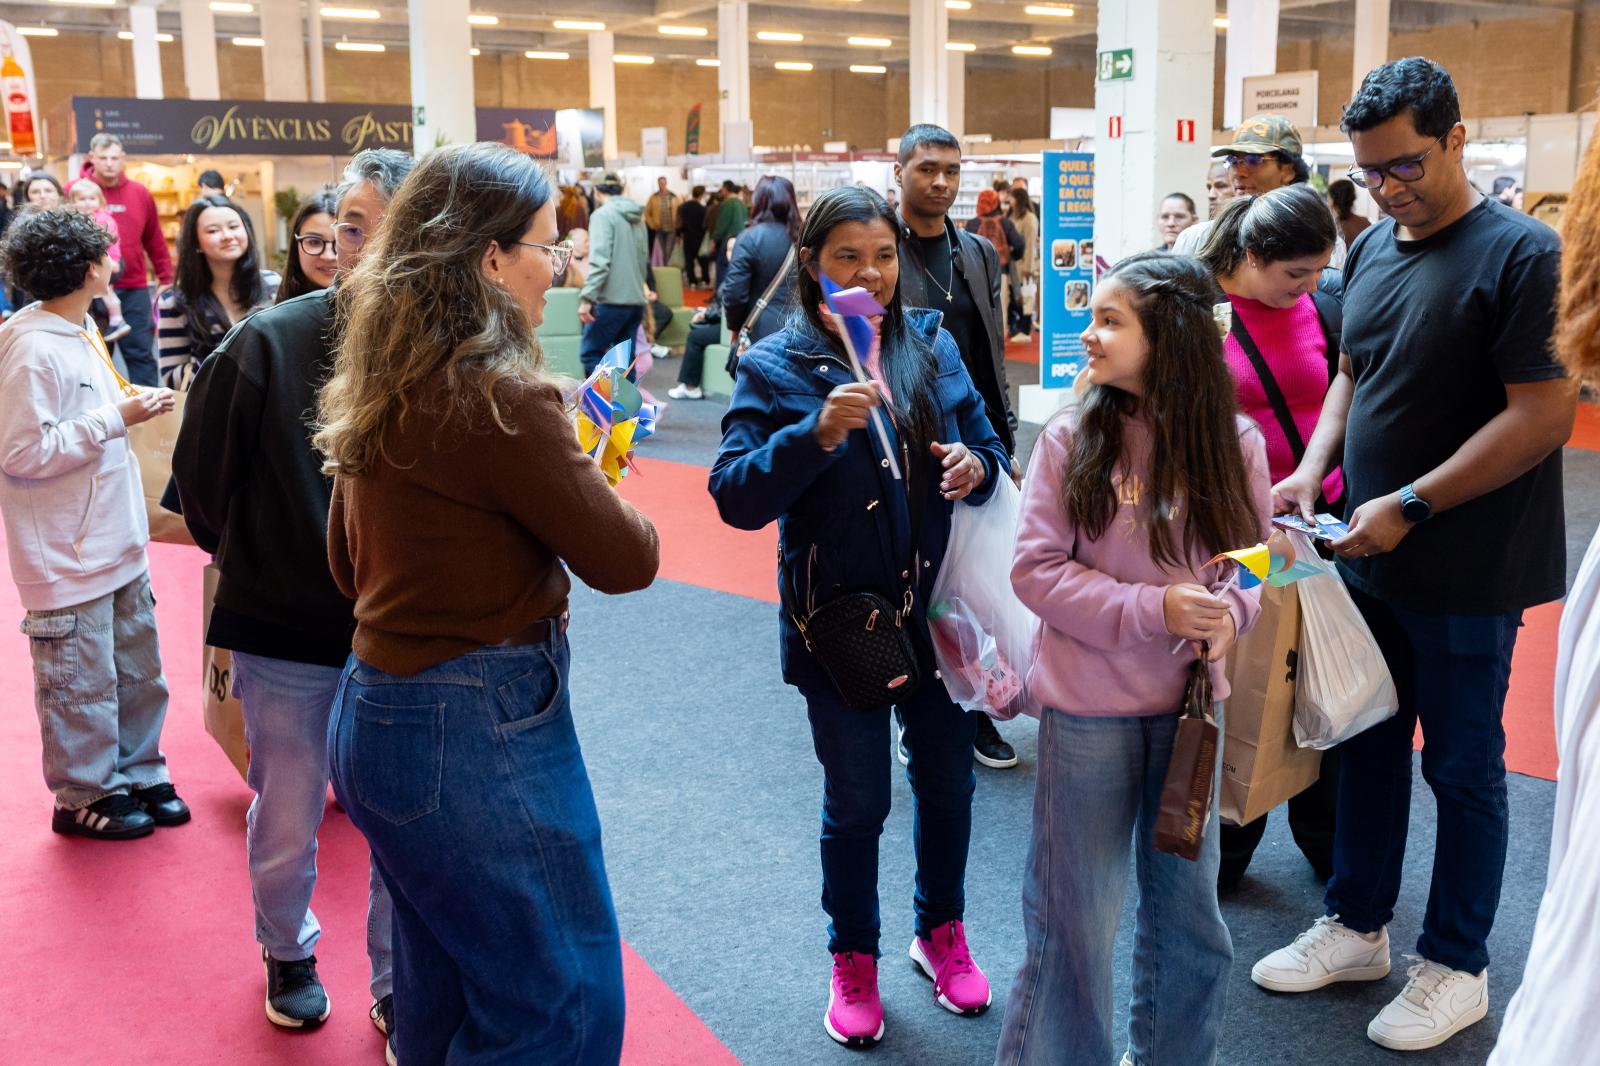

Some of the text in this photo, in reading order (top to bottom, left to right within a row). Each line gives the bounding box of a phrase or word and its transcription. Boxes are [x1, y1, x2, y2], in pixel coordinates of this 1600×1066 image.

[1256, 88, 1300, 97] PORCELANAS
[1059, 160, 1087, 172] QUER
[1059, 174, 1067, 186] O
[1069, 174, 1089, 186] QUE
[1059, 187, 1075, 199] EM
[1051, 363, 1078, 377] RPC
